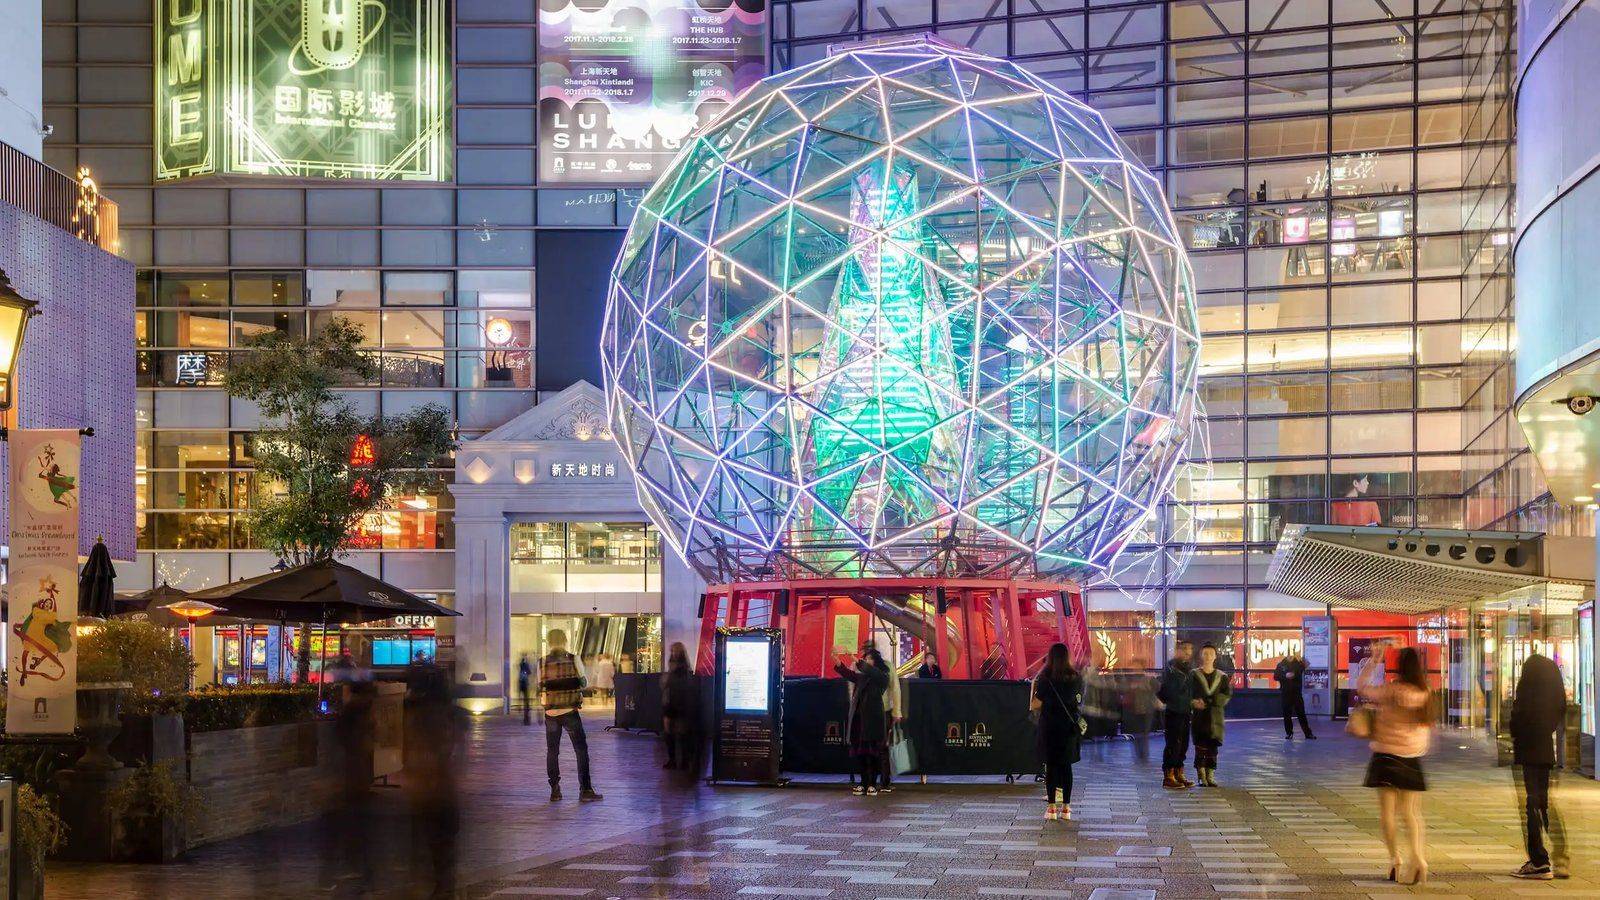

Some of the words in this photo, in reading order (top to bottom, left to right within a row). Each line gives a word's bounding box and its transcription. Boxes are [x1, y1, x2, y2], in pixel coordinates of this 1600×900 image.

[580, 67, 618, 76] 上海新天地
[564, 78, 599, 87] Shanghai
[600, 78, 634, 86] Xintiandi
[564, 88, 634, 96] 2017.11.22-2018.1.7
[275, 85, 396, 119] 国际影城
[176, 352, 206, 384] 摩
[551, 462, 615, 477] 新天地时尚
